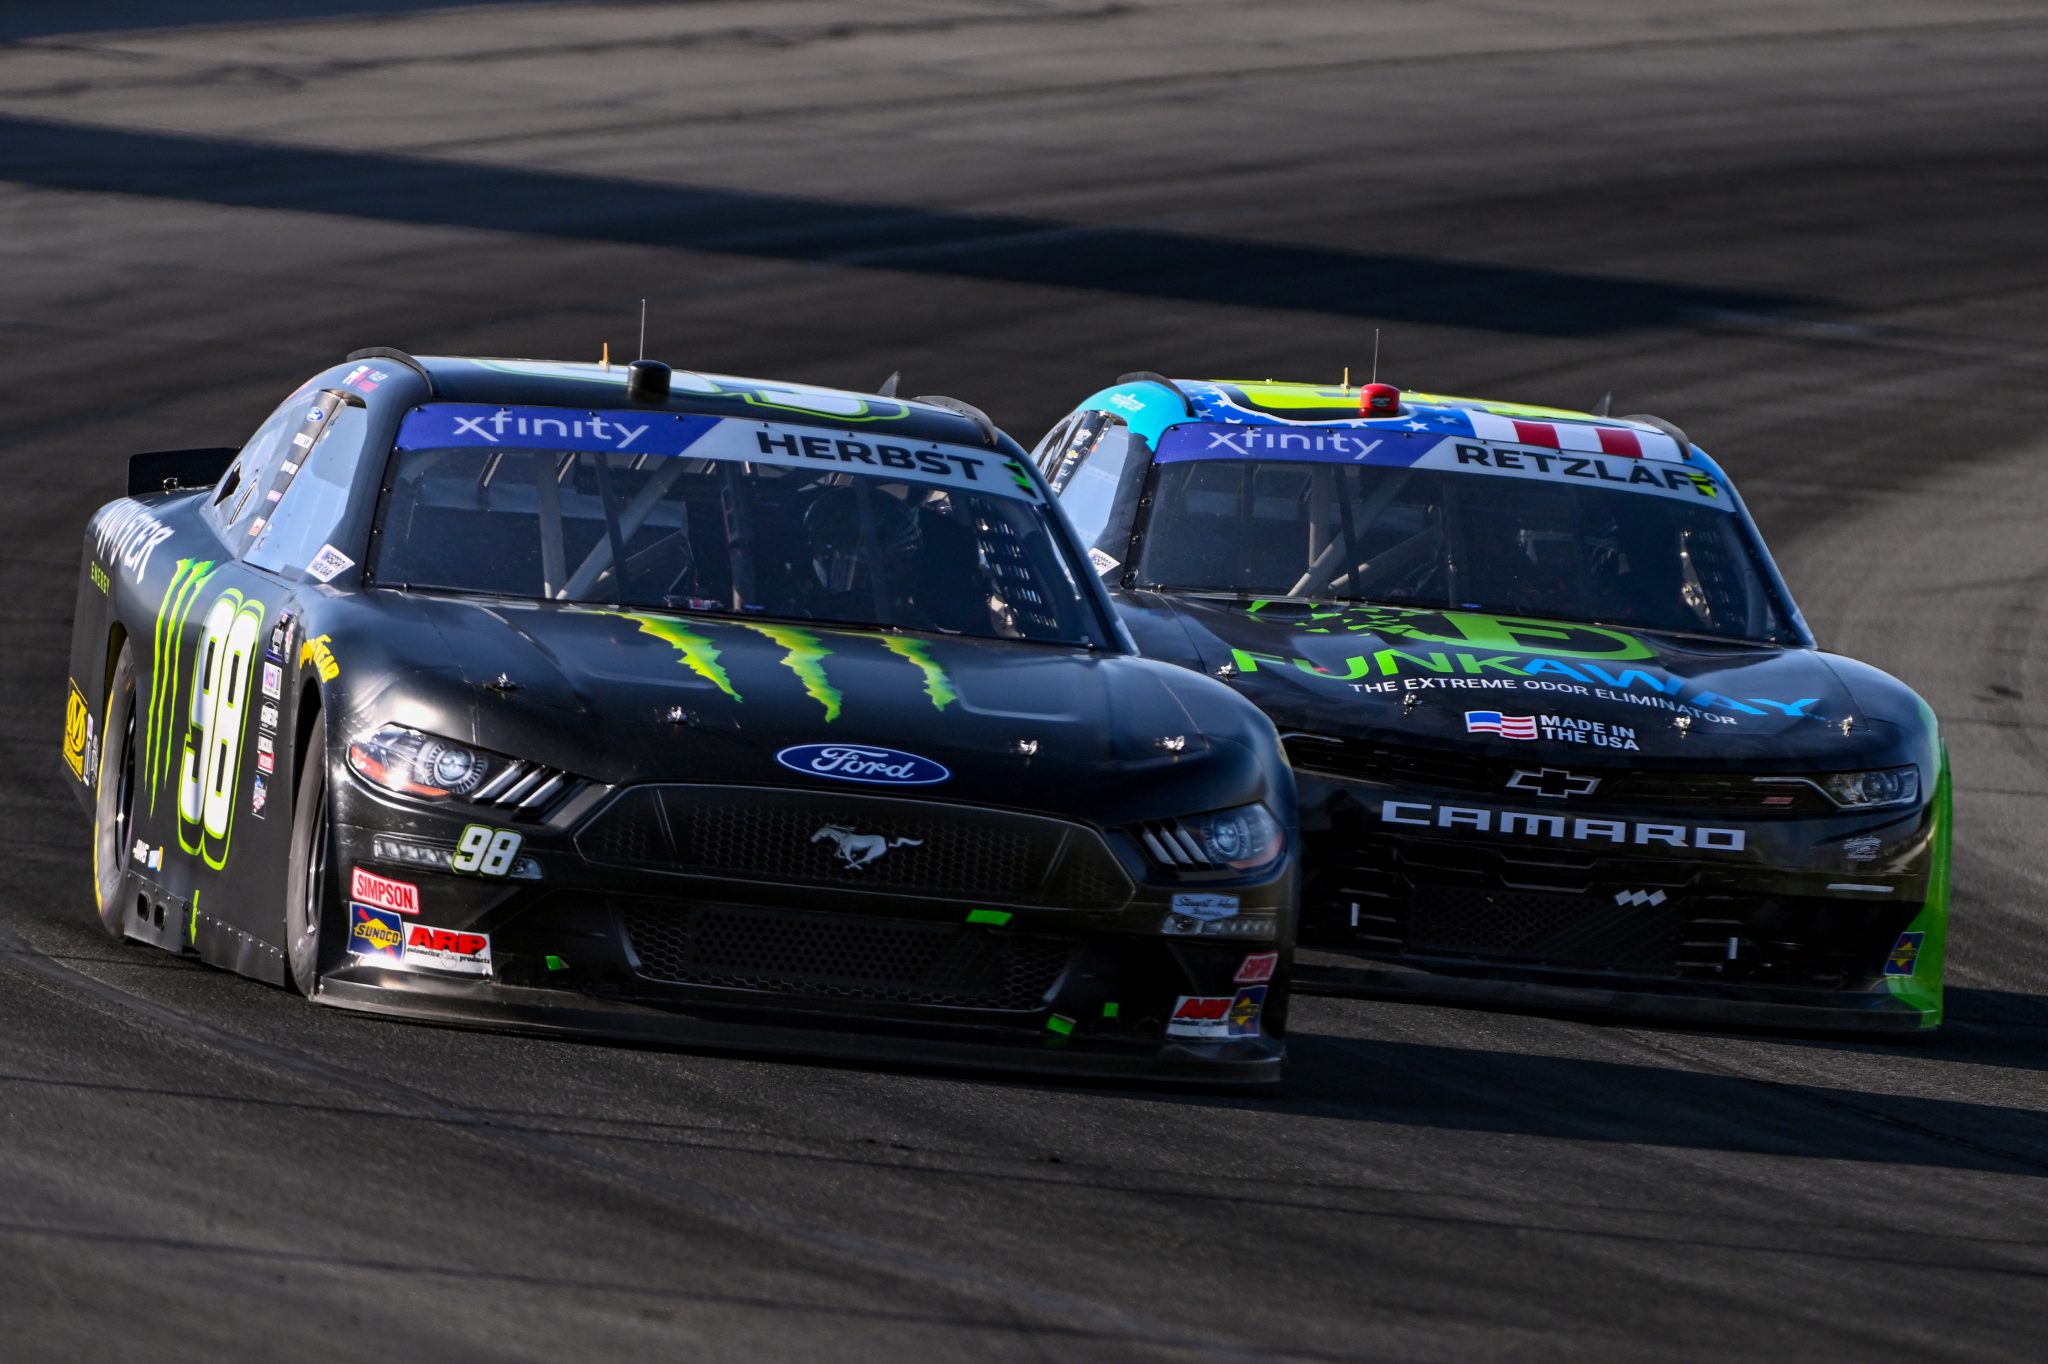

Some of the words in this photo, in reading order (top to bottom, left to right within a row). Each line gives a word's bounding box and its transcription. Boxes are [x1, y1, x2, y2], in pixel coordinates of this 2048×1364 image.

[453, 410, 649, 449] xfinity
[1208, 427, 1384, 460] xfinity
[756, 431, 984, 481] HERBST
[1231, 648, 1820, 716] FUNKAWAY
[1348, 680, 1398, 693] THE
[1404, 677, 1517, 690] EXTREME
[1521, 679, 1588, 696] ODOR
[1595, 688, 1739, 725] ELIMINATOR
[178, 587, 265, 870] 98
[1541, 714, 1605, 734] MADE
[1612, 724, 1636, 739] IN
[1541, 727, 1587, 744] THE
[1592, 733, 1640, 750] USA
[811, 747, 916, 779] Ford
[1381, 800, 1745, 851] CAMARO
[452, 824, 524, 877] 98
[356, 873, 414, 911] SIMPSON
[357, 924, 400, 944] SUNOCO
[407, 926, 487, 956] ARP
[459, 954, 490, 964] products
